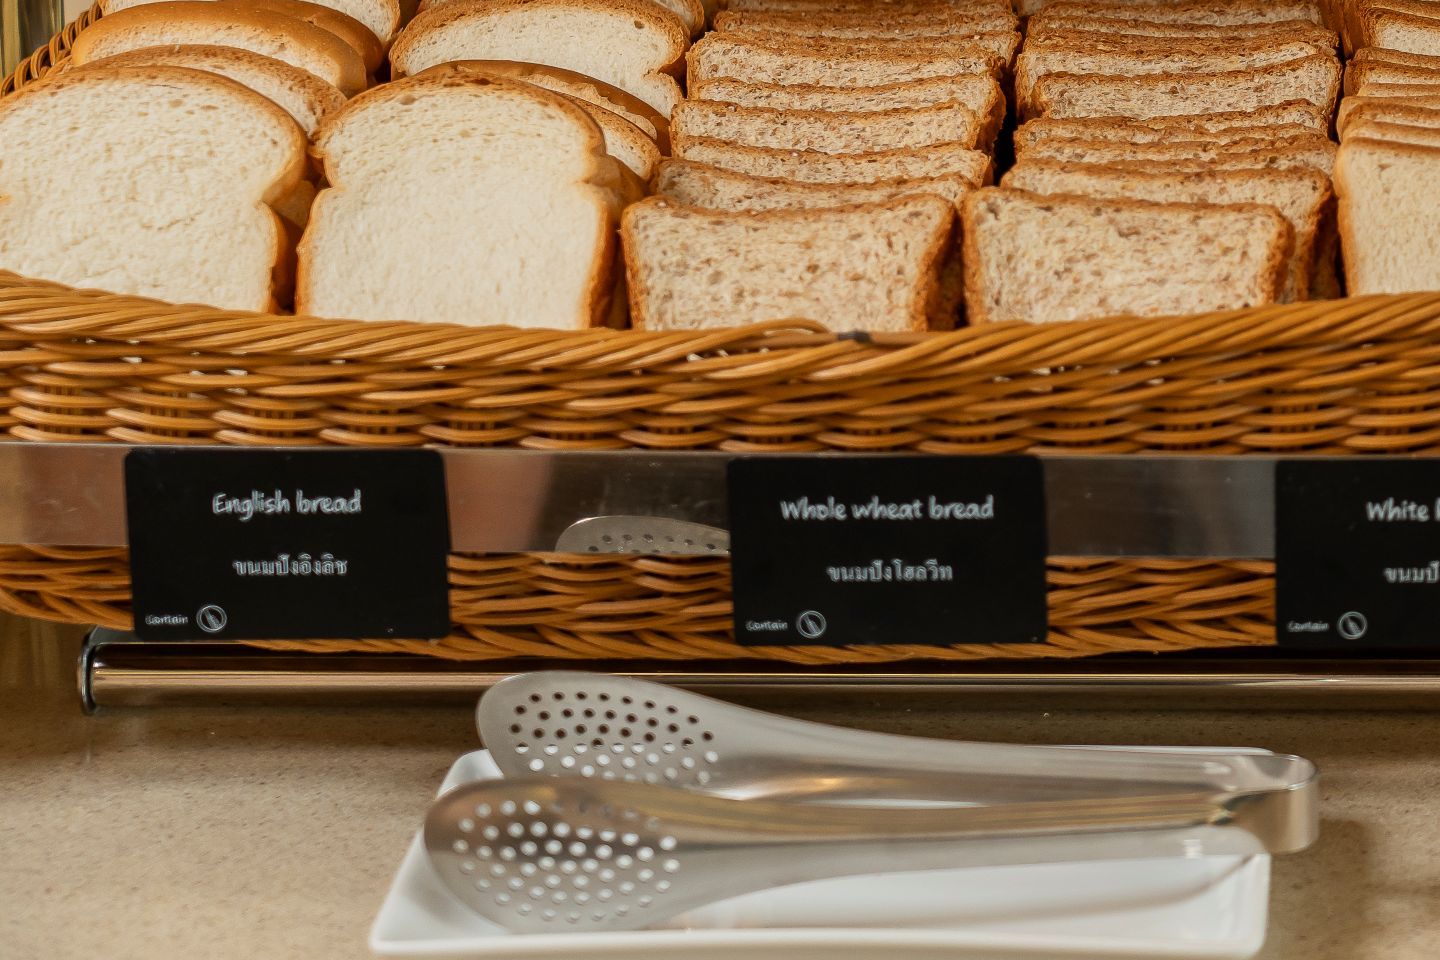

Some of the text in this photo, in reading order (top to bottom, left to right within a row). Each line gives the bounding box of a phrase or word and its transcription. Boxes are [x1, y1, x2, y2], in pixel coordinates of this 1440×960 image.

[212, 488, 363, 522] English bread
[780, 494, 995, 521] Whole wheat bread
[1366, 497, 1430, 522] White
